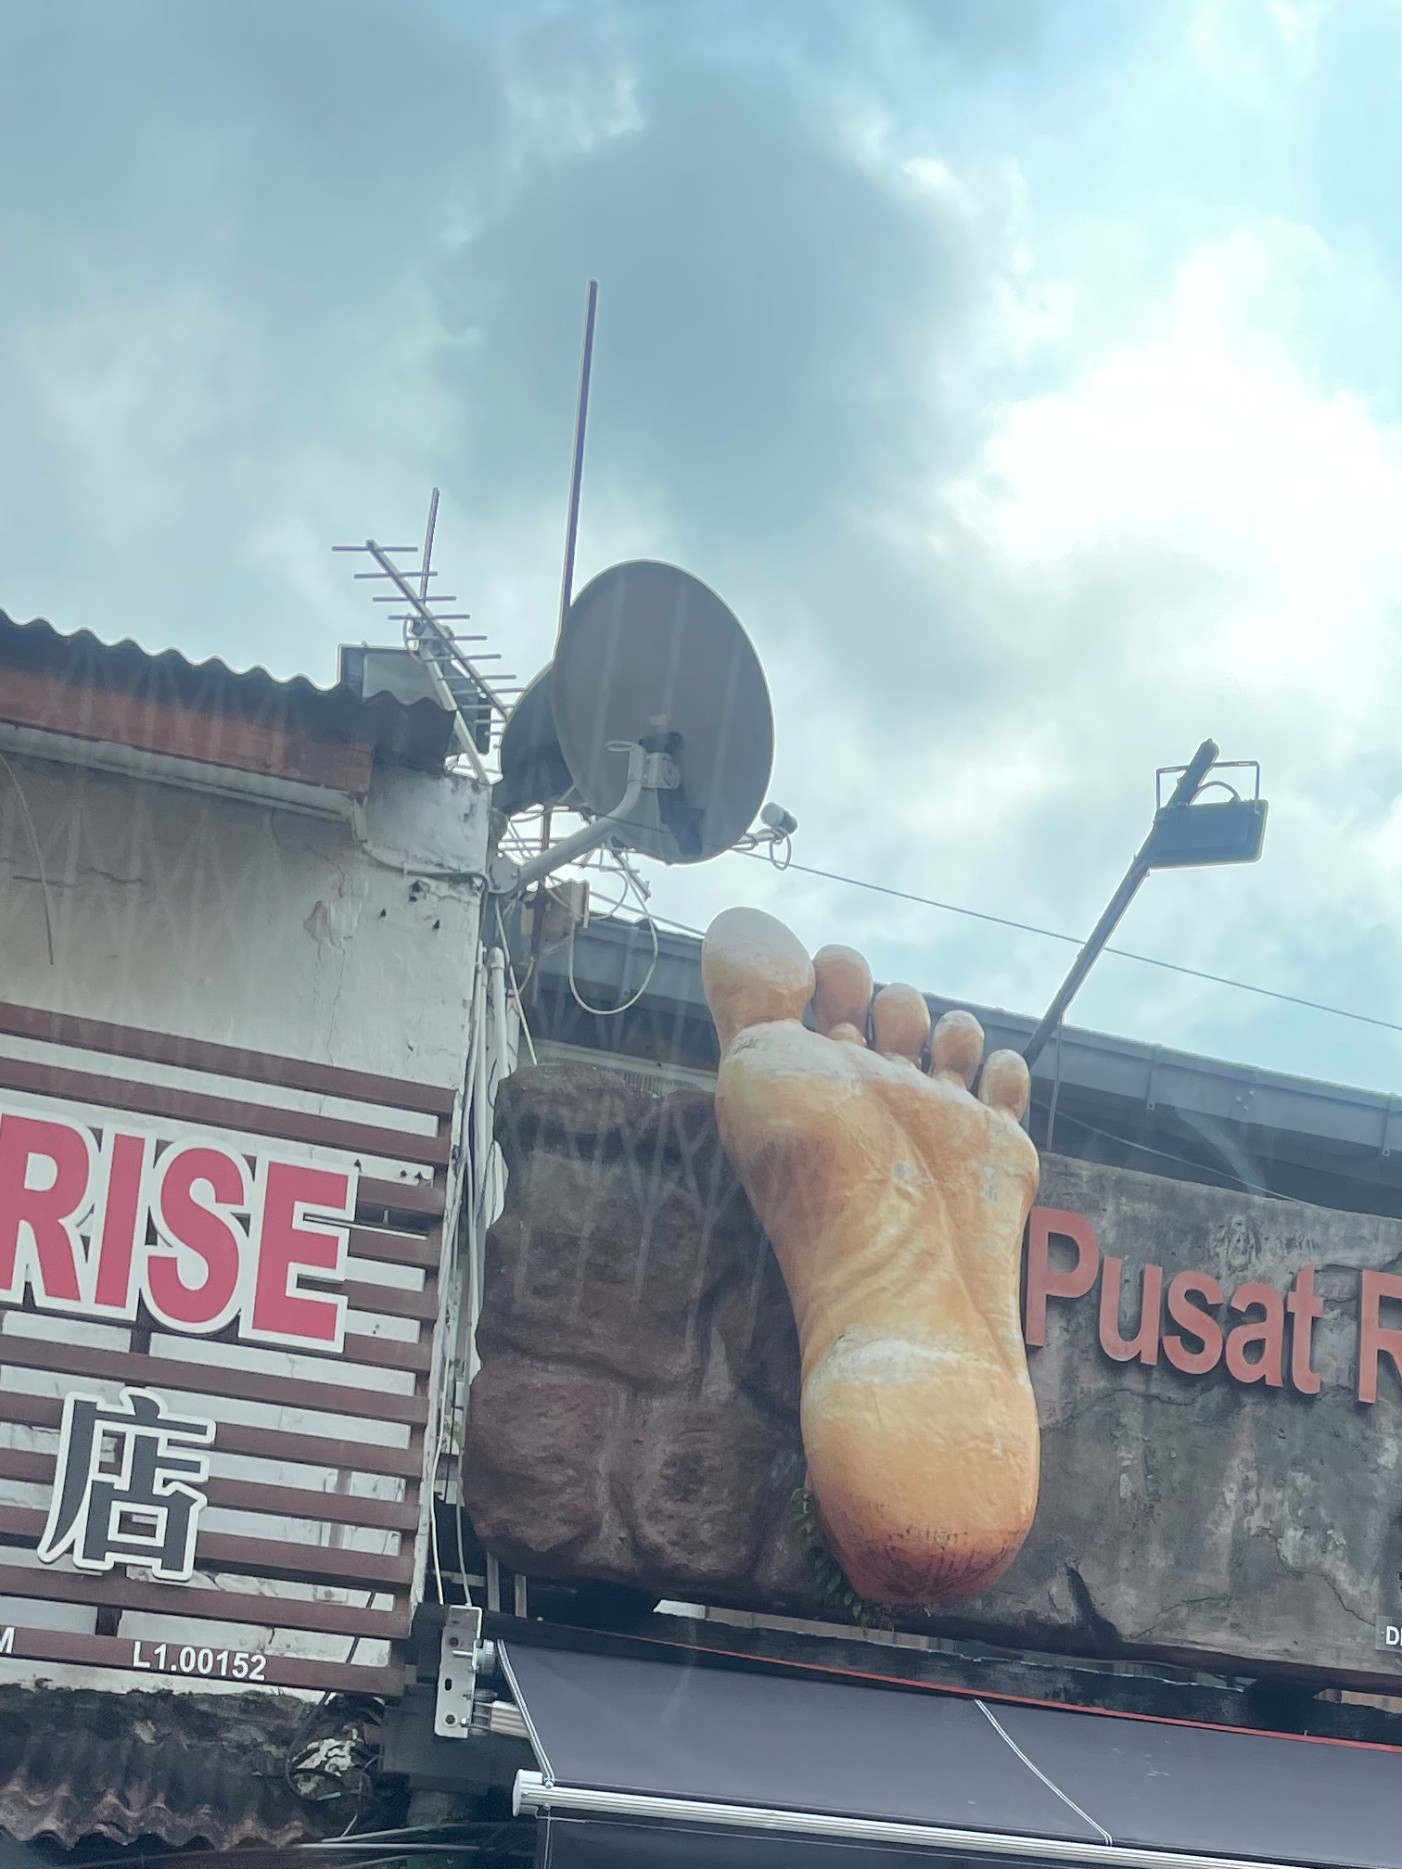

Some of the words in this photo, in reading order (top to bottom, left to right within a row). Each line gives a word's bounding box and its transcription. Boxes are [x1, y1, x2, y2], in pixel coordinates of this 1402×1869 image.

[0, 1108, 356, 1350] RISE
[1026, 1206, 1324, 1396] Pusat
[38, 1387, 215, 1580] 店
[132, 1641, 267, 1682] L1.00152
